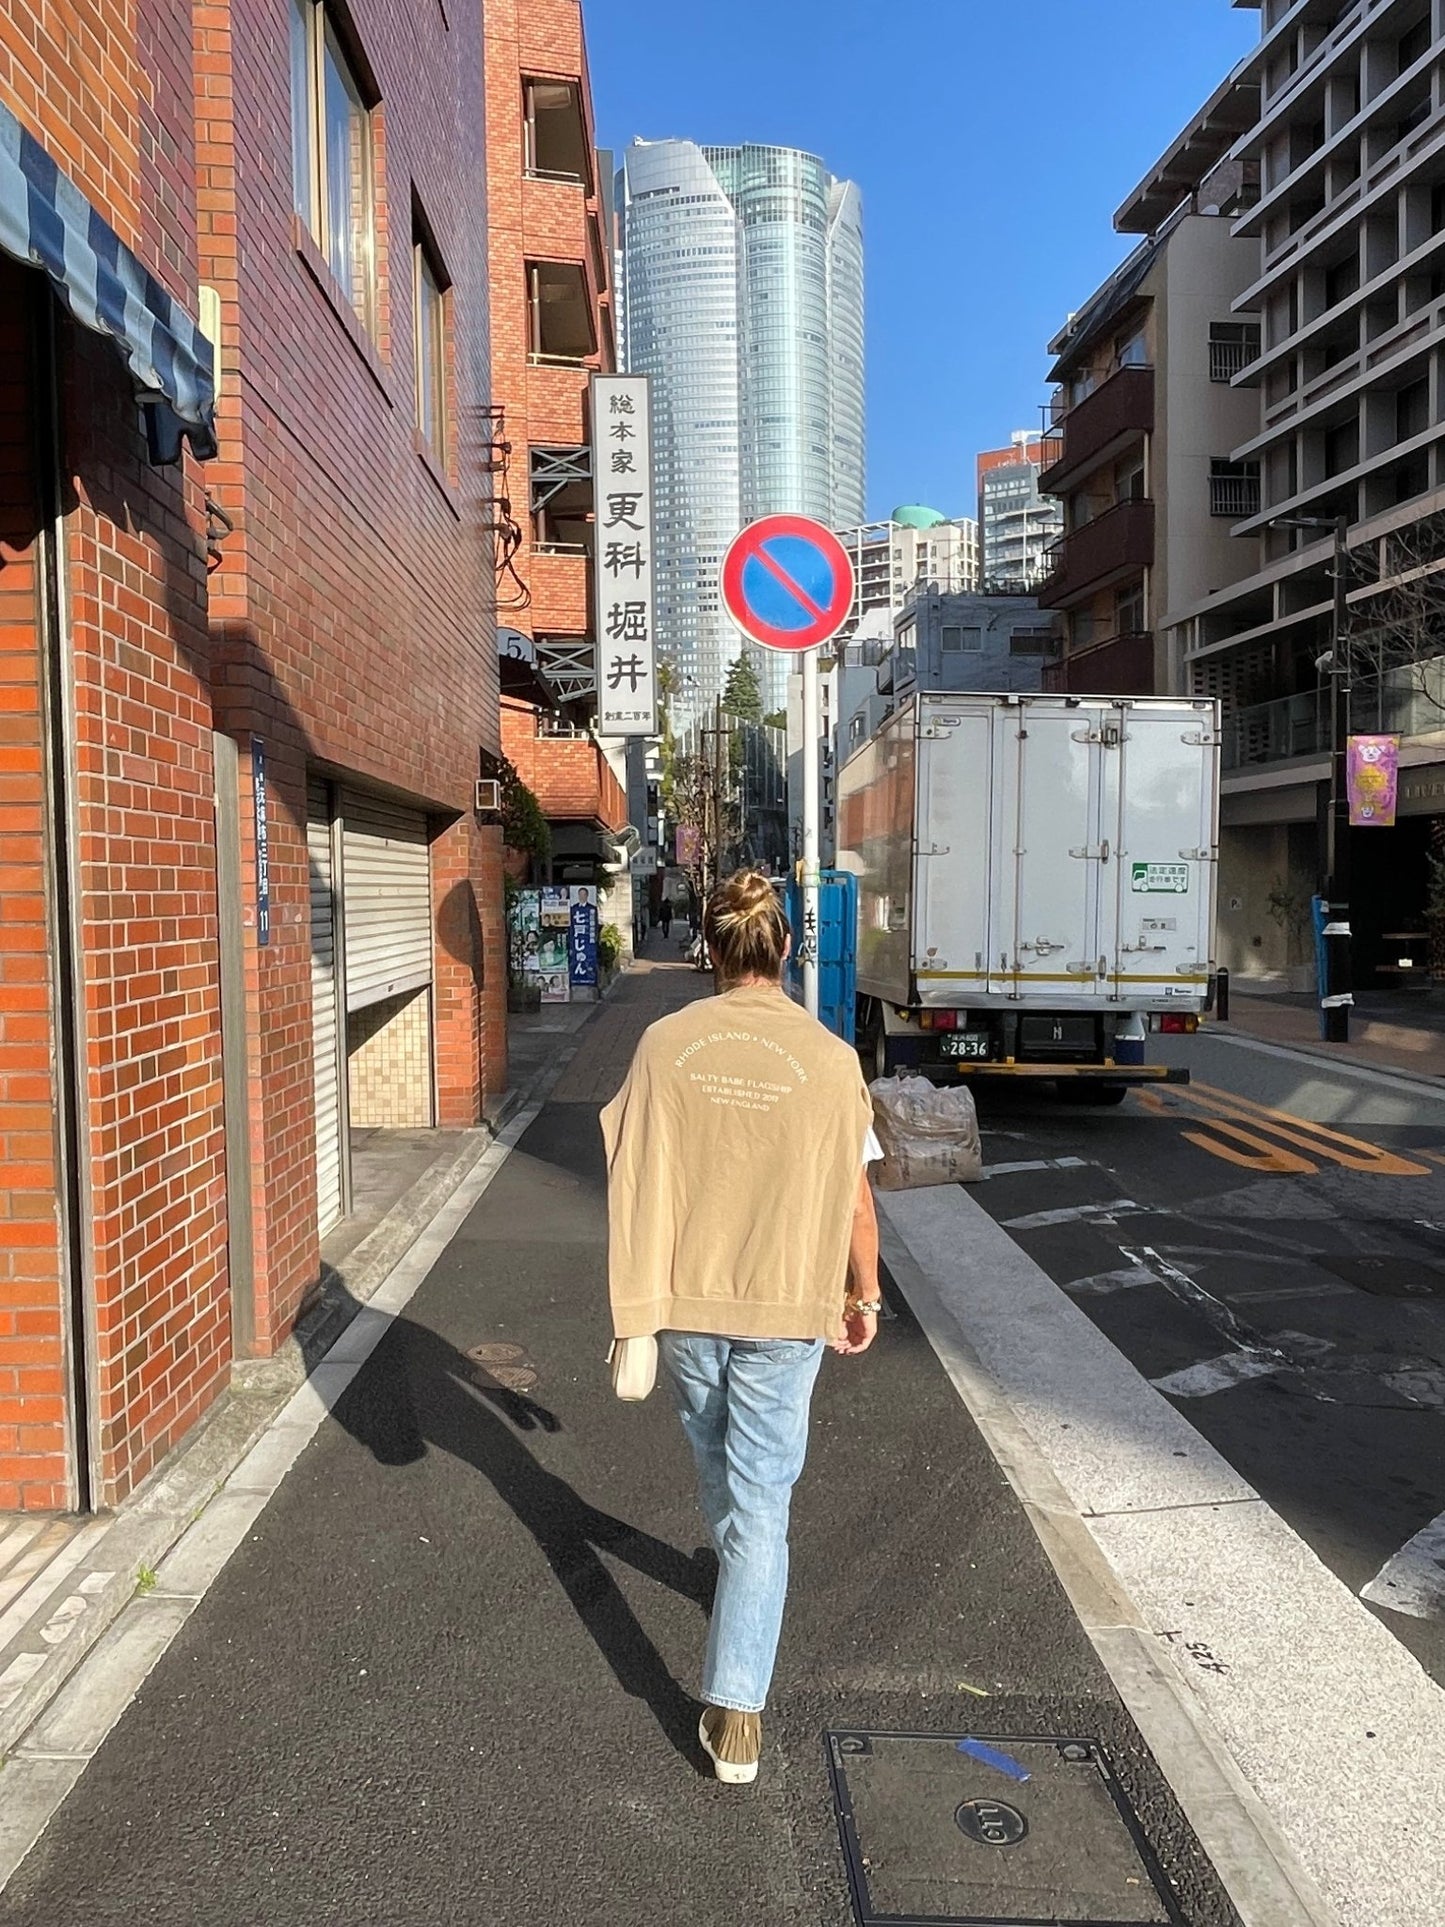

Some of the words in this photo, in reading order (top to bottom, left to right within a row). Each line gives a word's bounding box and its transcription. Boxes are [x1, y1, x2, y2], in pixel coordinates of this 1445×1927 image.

[259, 910, 269, 931] 11
[573, 911, 587, 975] 七戸じゅん
[674, 1037, 707, 1068] RHODE
[708, 1031, 751, 1043] ISLAND
[761, 1037, 787, 1055] NEW
[785, 1054, 809, 1084] YORK
[690, 1072, 719, 1083] SALTY
[721, 1076, 744, 1087] BABE
[747, 1079, 793, 1094] FLAGSHIP
[702, 1085, 761, 1099] ESTABLISHED
[710, 1097, 729, 1105] NEW
[731, 1099, 770, 1112] ENGLAND
